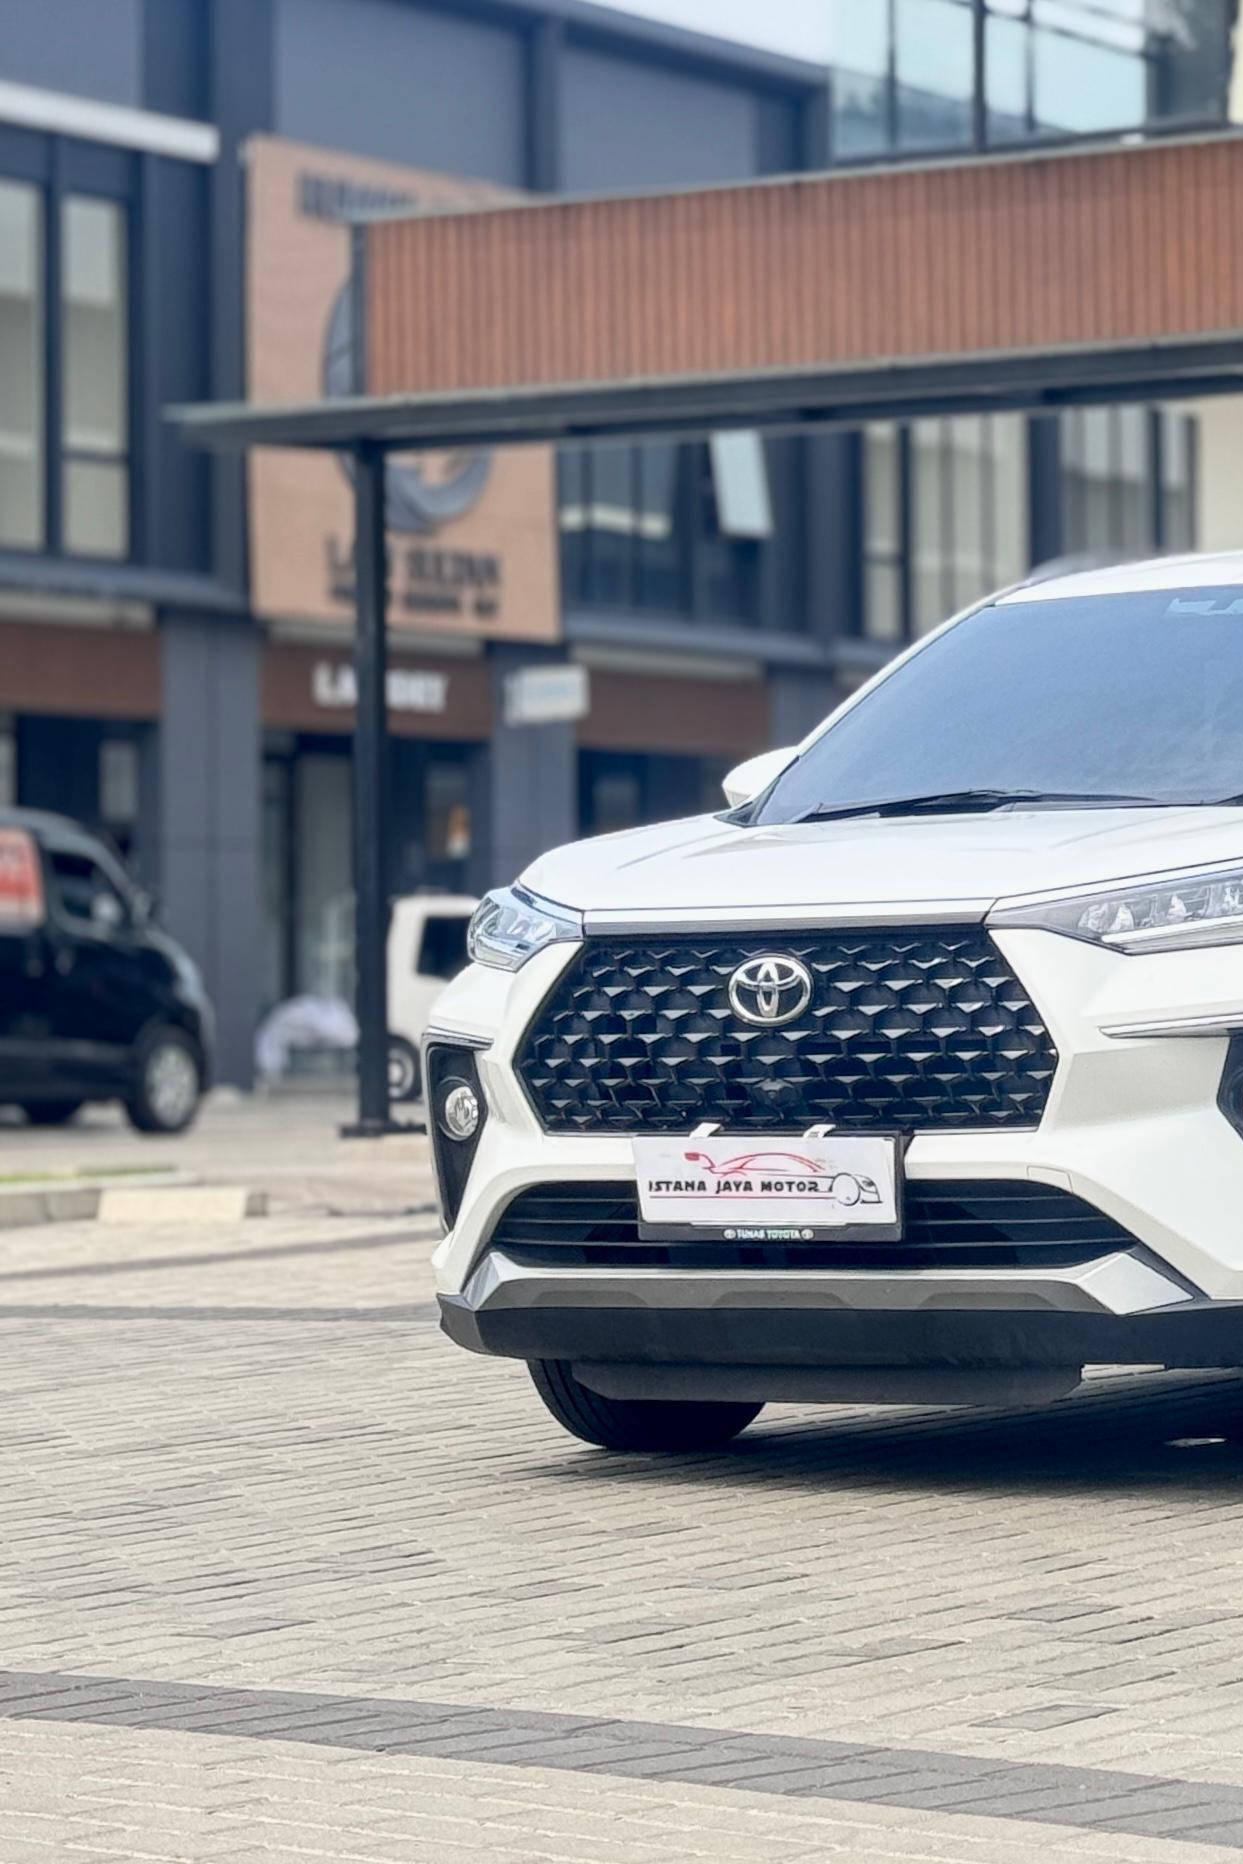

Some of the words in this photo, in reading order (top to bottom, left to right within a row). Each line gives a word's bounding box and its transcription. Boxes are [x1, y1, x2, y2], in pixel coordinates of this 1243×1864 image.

[649, 1180, 707, 1192] ISTANA
[715, 1180, 753, 1195] JAYA
[760, 1180, 819, 1193] MOTOR
[766, 1228, 800, 1240] TOYOTA
